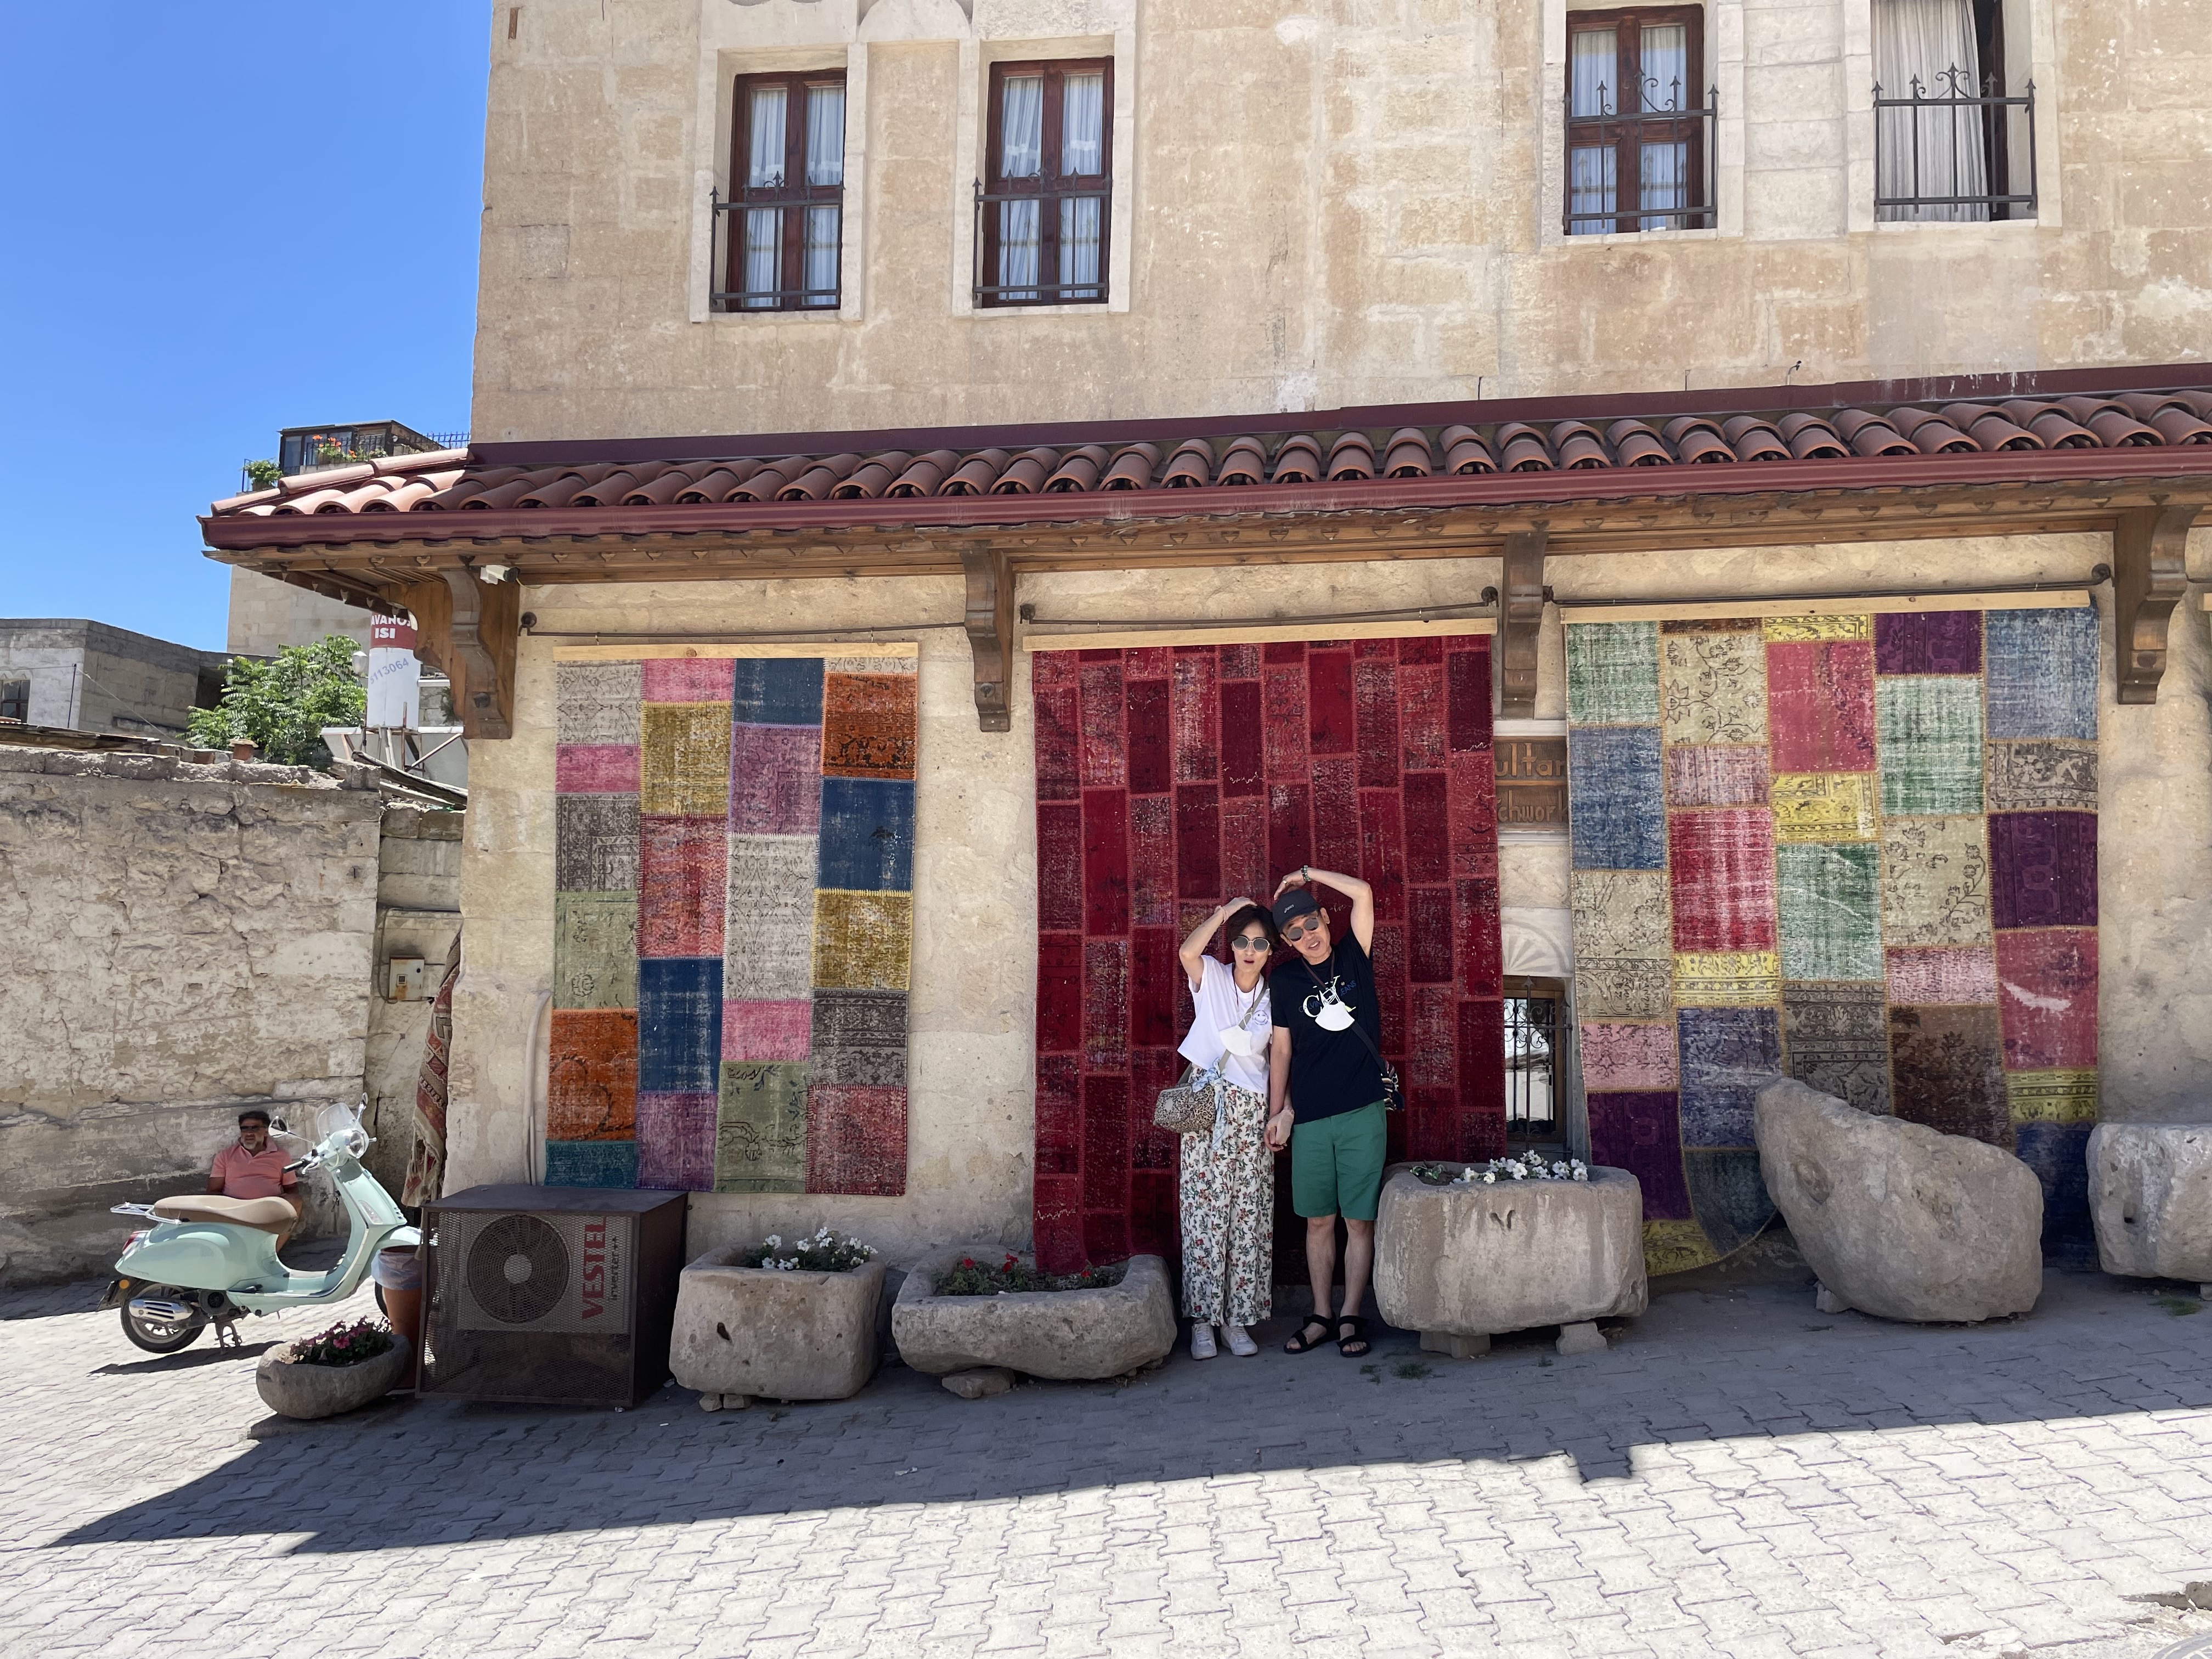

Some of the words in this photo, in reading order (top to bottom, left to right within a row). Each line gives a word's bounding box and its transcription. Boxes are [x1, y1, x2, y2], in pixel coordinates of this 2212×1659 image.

[370, 658, 409, 685] 5113064
[1497, 790, 1568, 822] chwork
[582, 1216, 606, 1320] VESTEL
